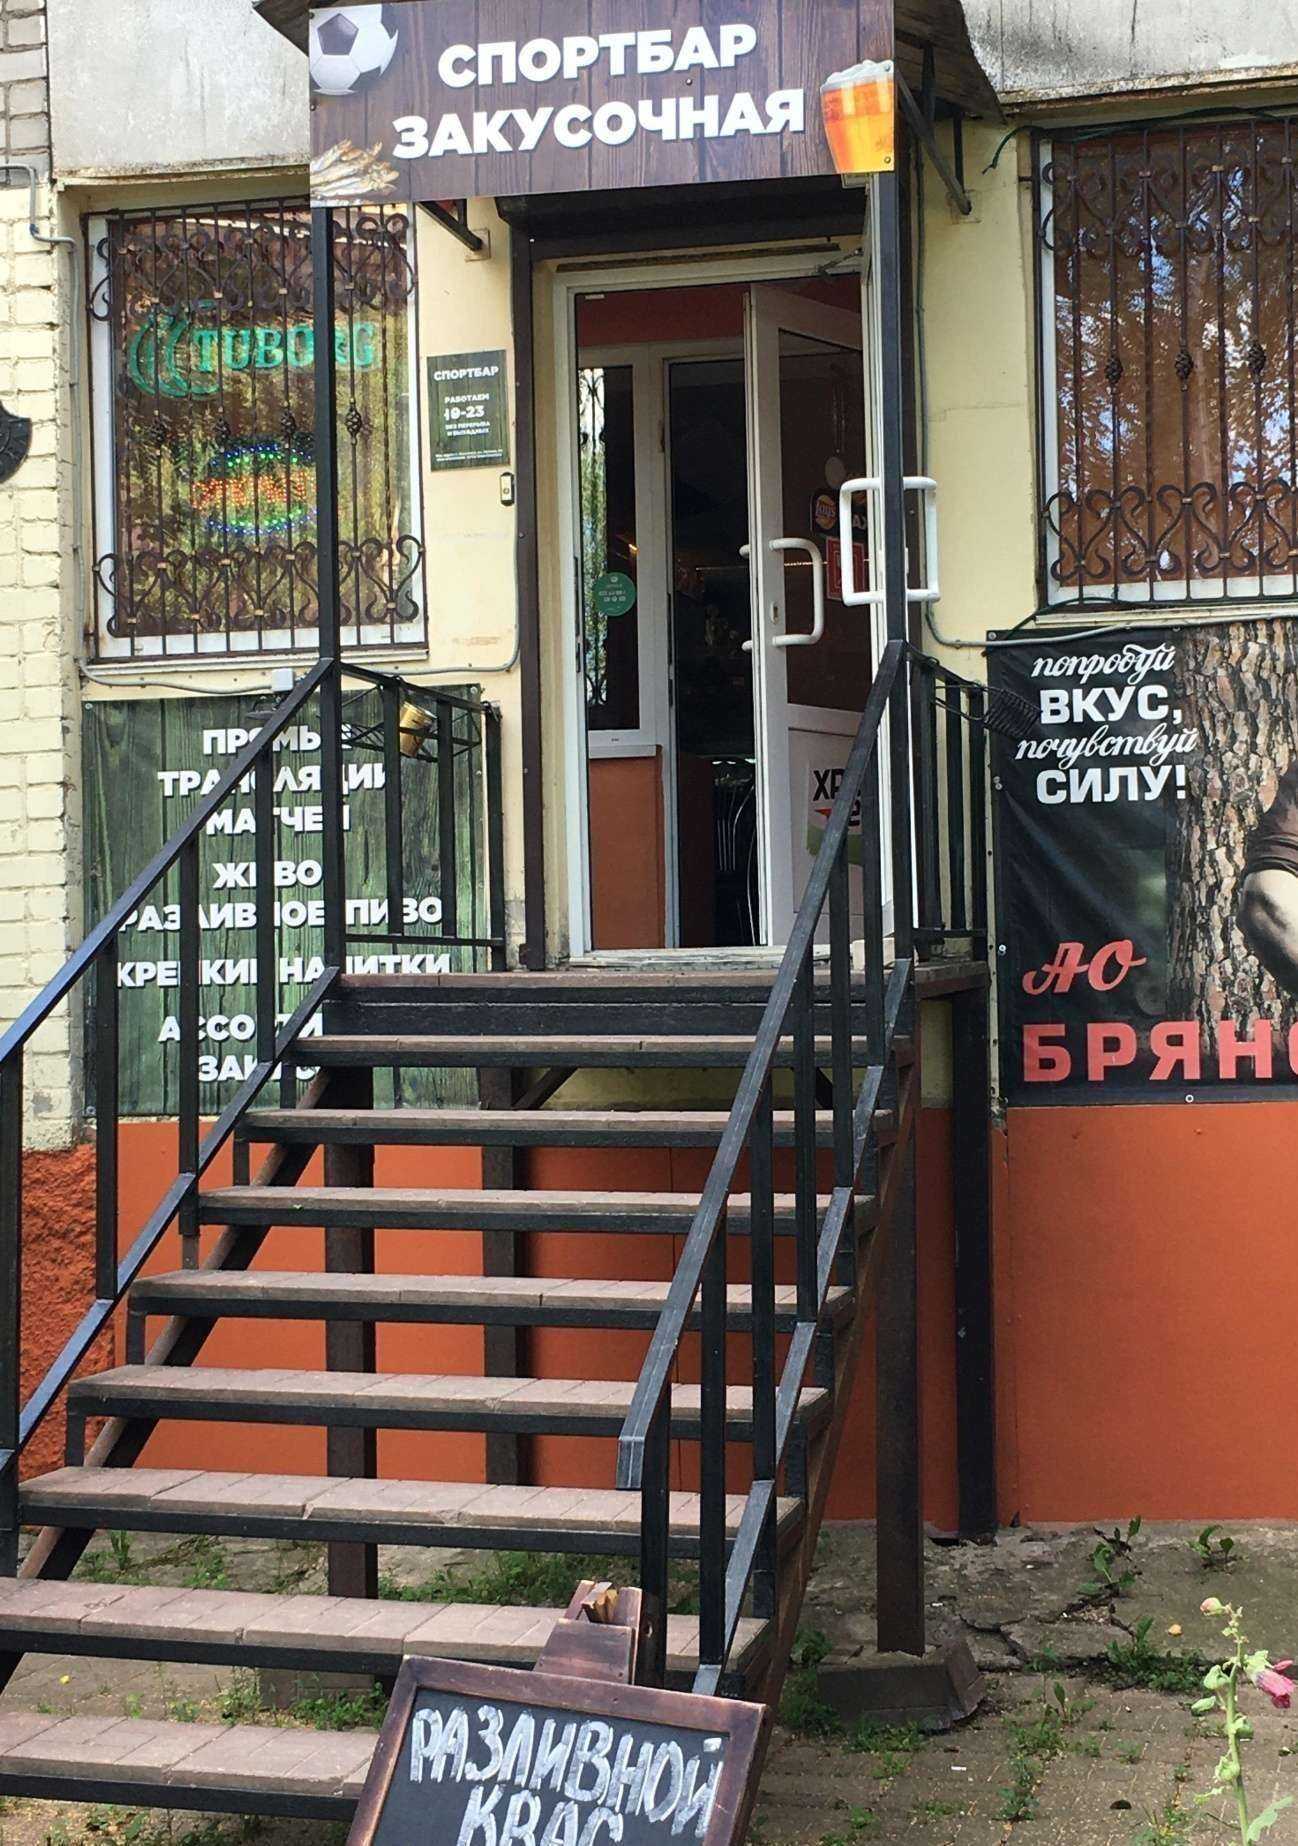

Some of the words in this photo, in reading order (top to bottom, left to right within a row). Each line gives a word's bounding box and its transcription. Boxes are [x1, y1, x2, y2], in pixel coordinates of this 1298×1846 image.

[437, 23, 757, 88] СПОРТБАР
[391, 88, 805, 160] ЗАКУСОЧНАЯ
[433, 366, 500, 381] СПОРТБАР
[1031, 643, 1176, 686] попробуй
[1040, 685, 1183, 725] ВКУС,
[1015, 722, 1199, 769] почувствуй
[1036, 765, 1187, 804] СИЛУ!
[206, 805, 350, 835] МАЧЕ
[117, 958, 258, 988] КРЕКИ
[280, 953, 450, 984] НАИТКИ
[1023, 1020, 1298, 1083] БРЯН
[409, 1703, 724, 1839] РАЗЛИВНОЙ
